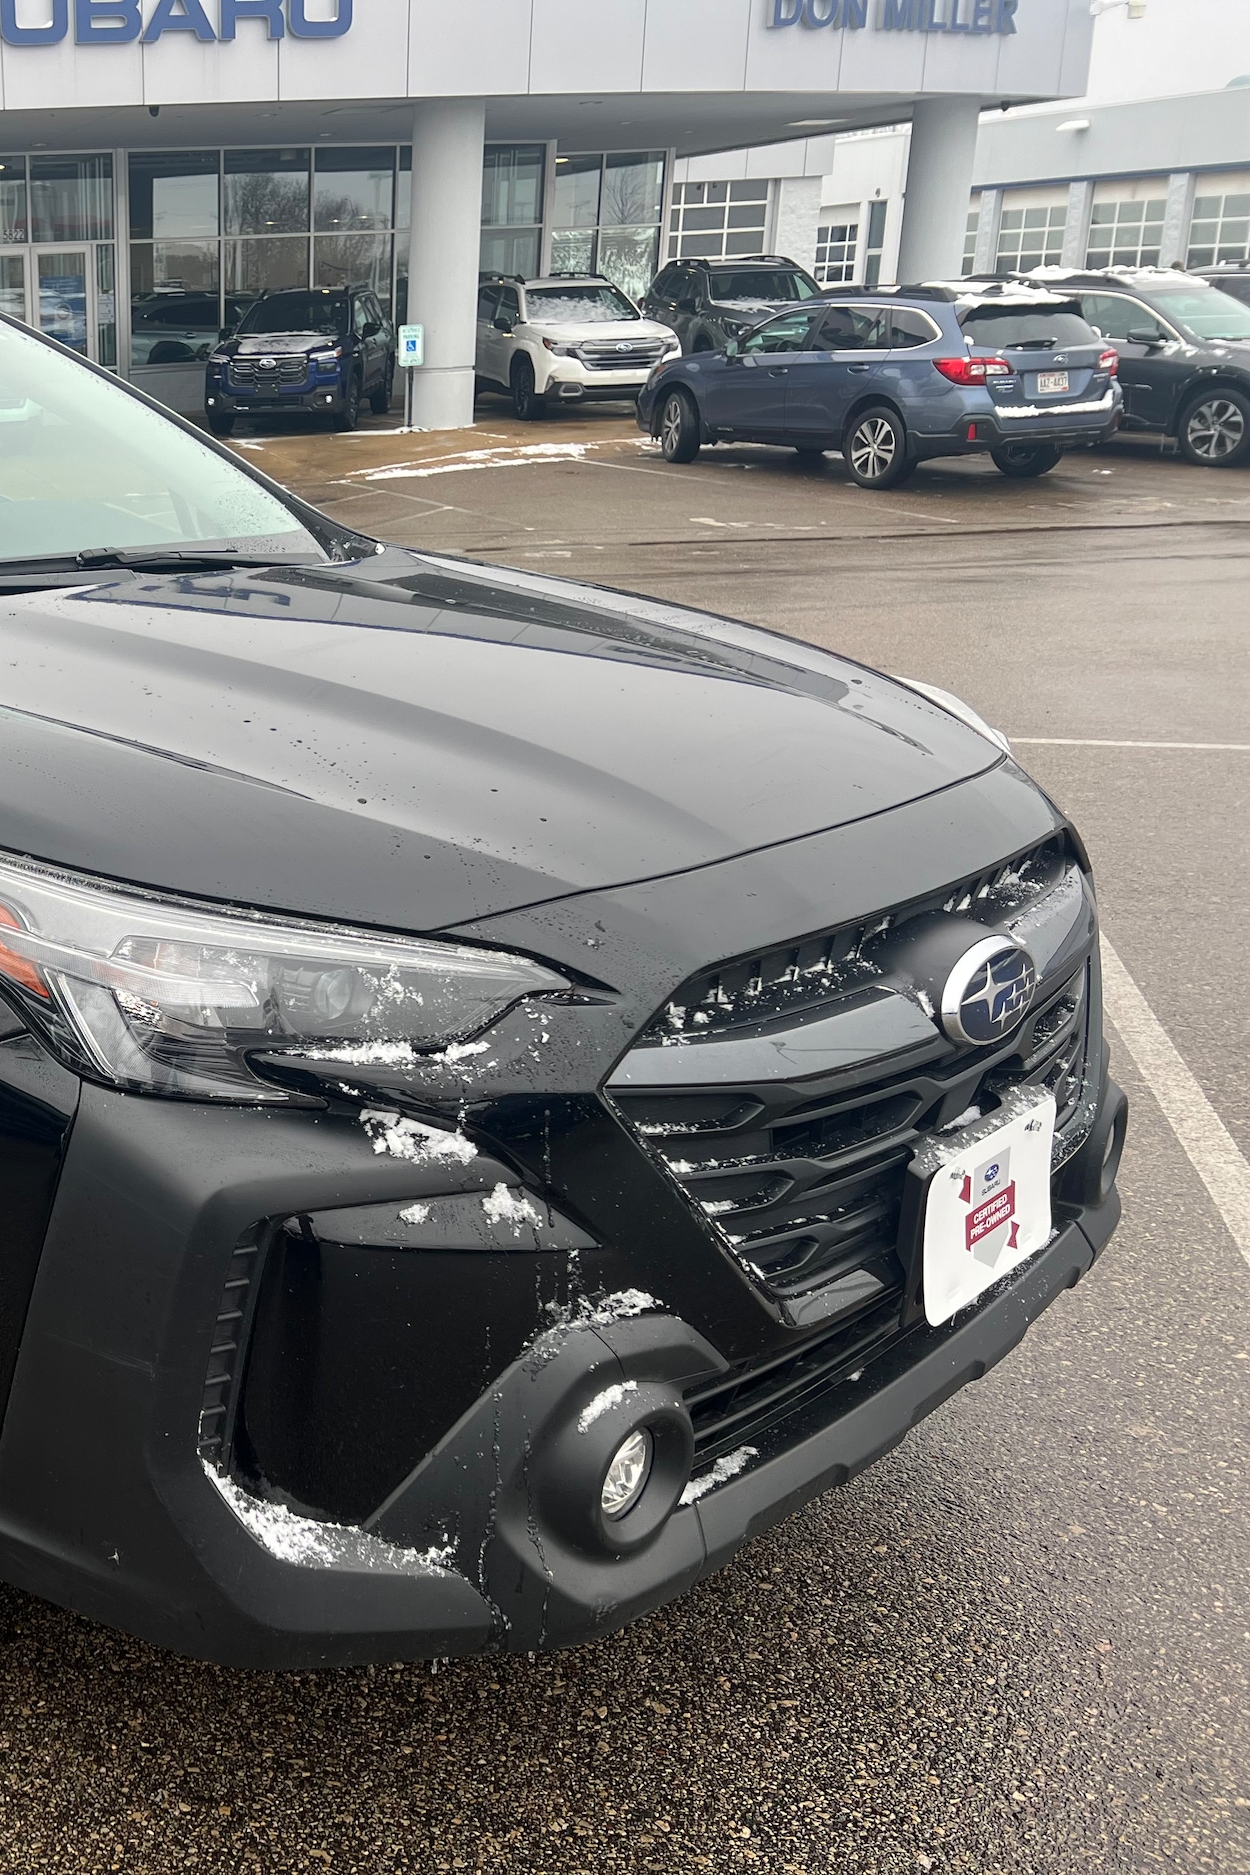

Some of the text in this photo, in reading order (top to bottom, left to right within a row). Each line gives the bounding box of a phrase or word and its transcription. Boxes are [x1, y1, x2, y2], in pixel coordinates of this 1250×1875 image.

[768, 0, 1018, 34] DON MILLER
[981, 1179, 1002, 1197] SUBARU
[970, 1203, 1011, 1240] PRE-OWNED
[973, 1193, 1008, 1225] CERTIFIED
